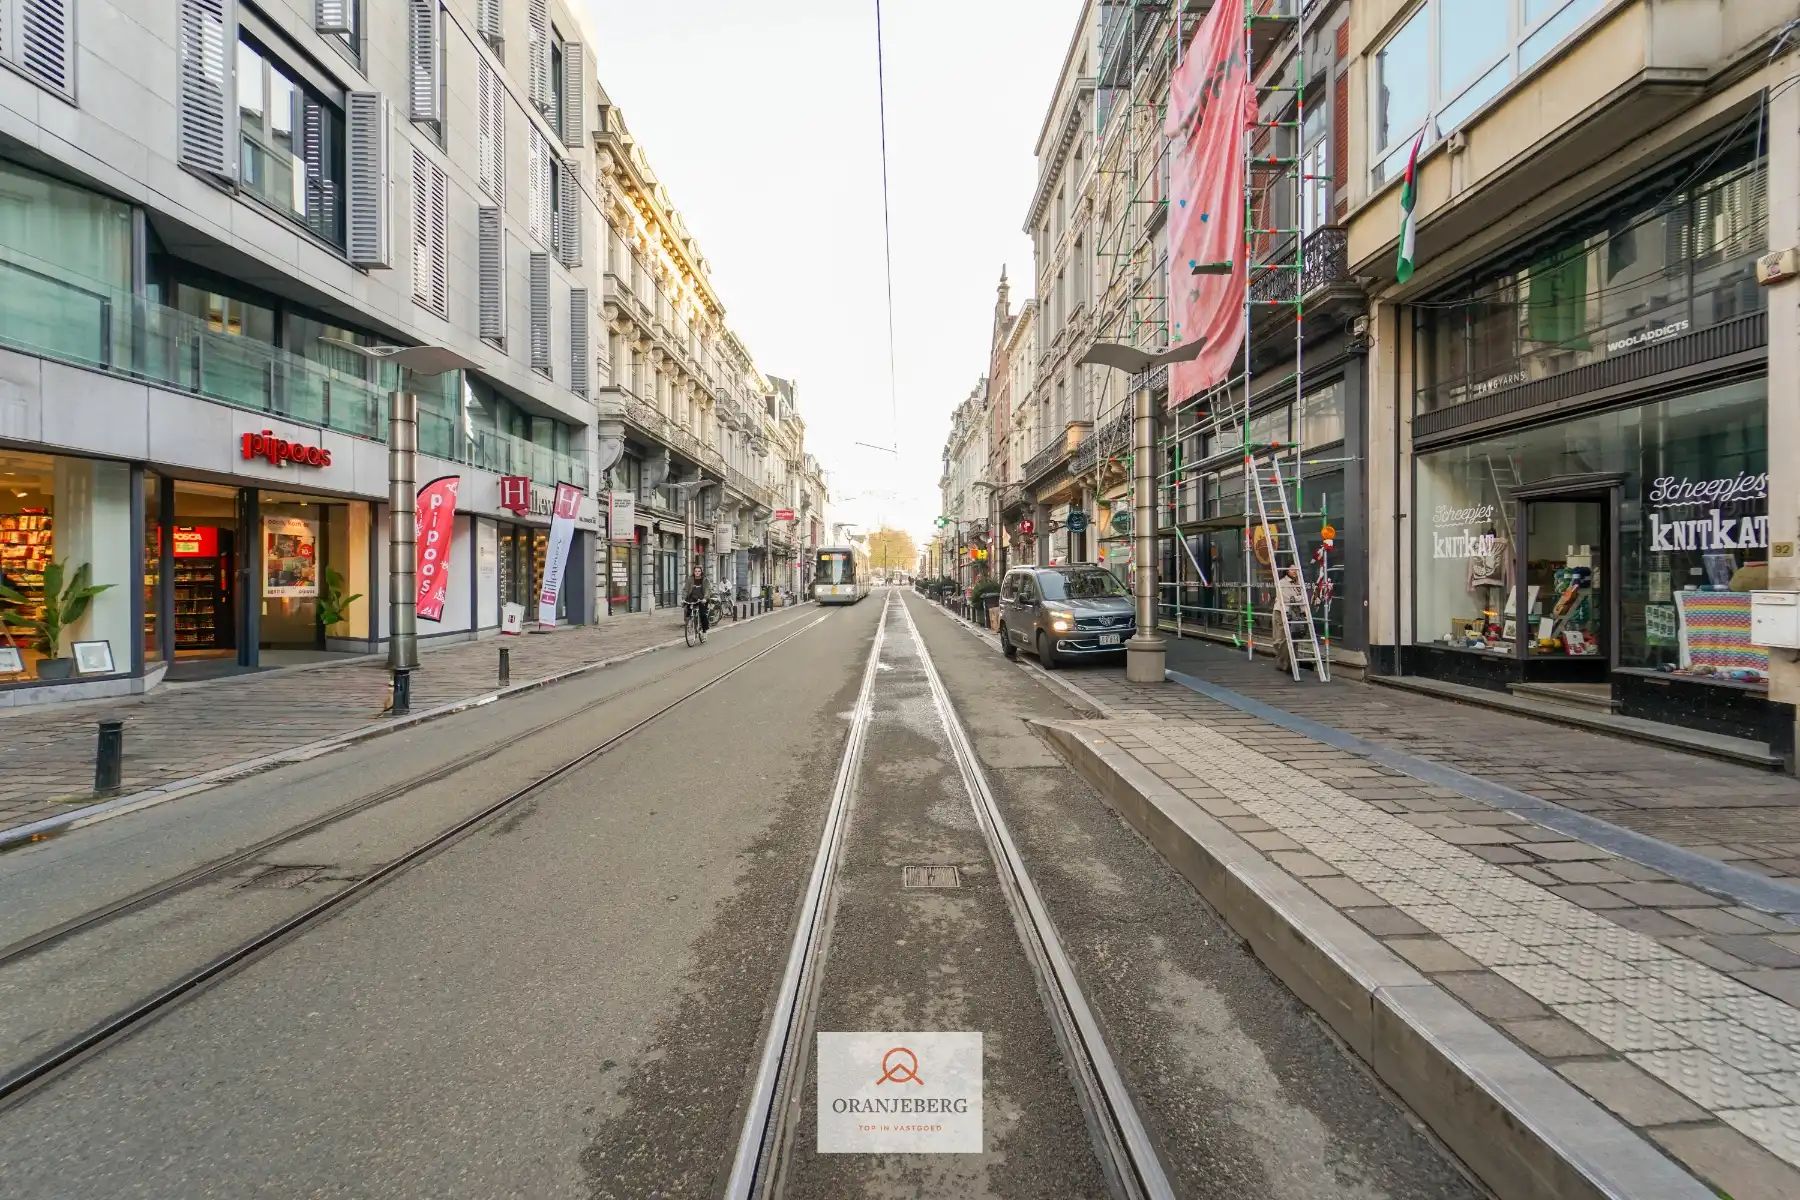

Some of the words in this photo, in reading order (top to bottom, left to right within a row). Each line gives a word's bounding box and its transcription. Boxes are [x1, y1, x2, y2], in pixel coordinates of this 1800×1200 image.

[1607, 320, 1689, 352] WOOLADDICTS
[241, 429, 332, 467] pipoos
[1649, 470, 1766, 502] Scheepjes
[1432, 503, 1492, 524] Scheepjes
[1775, 545, 1790, 554] 92
